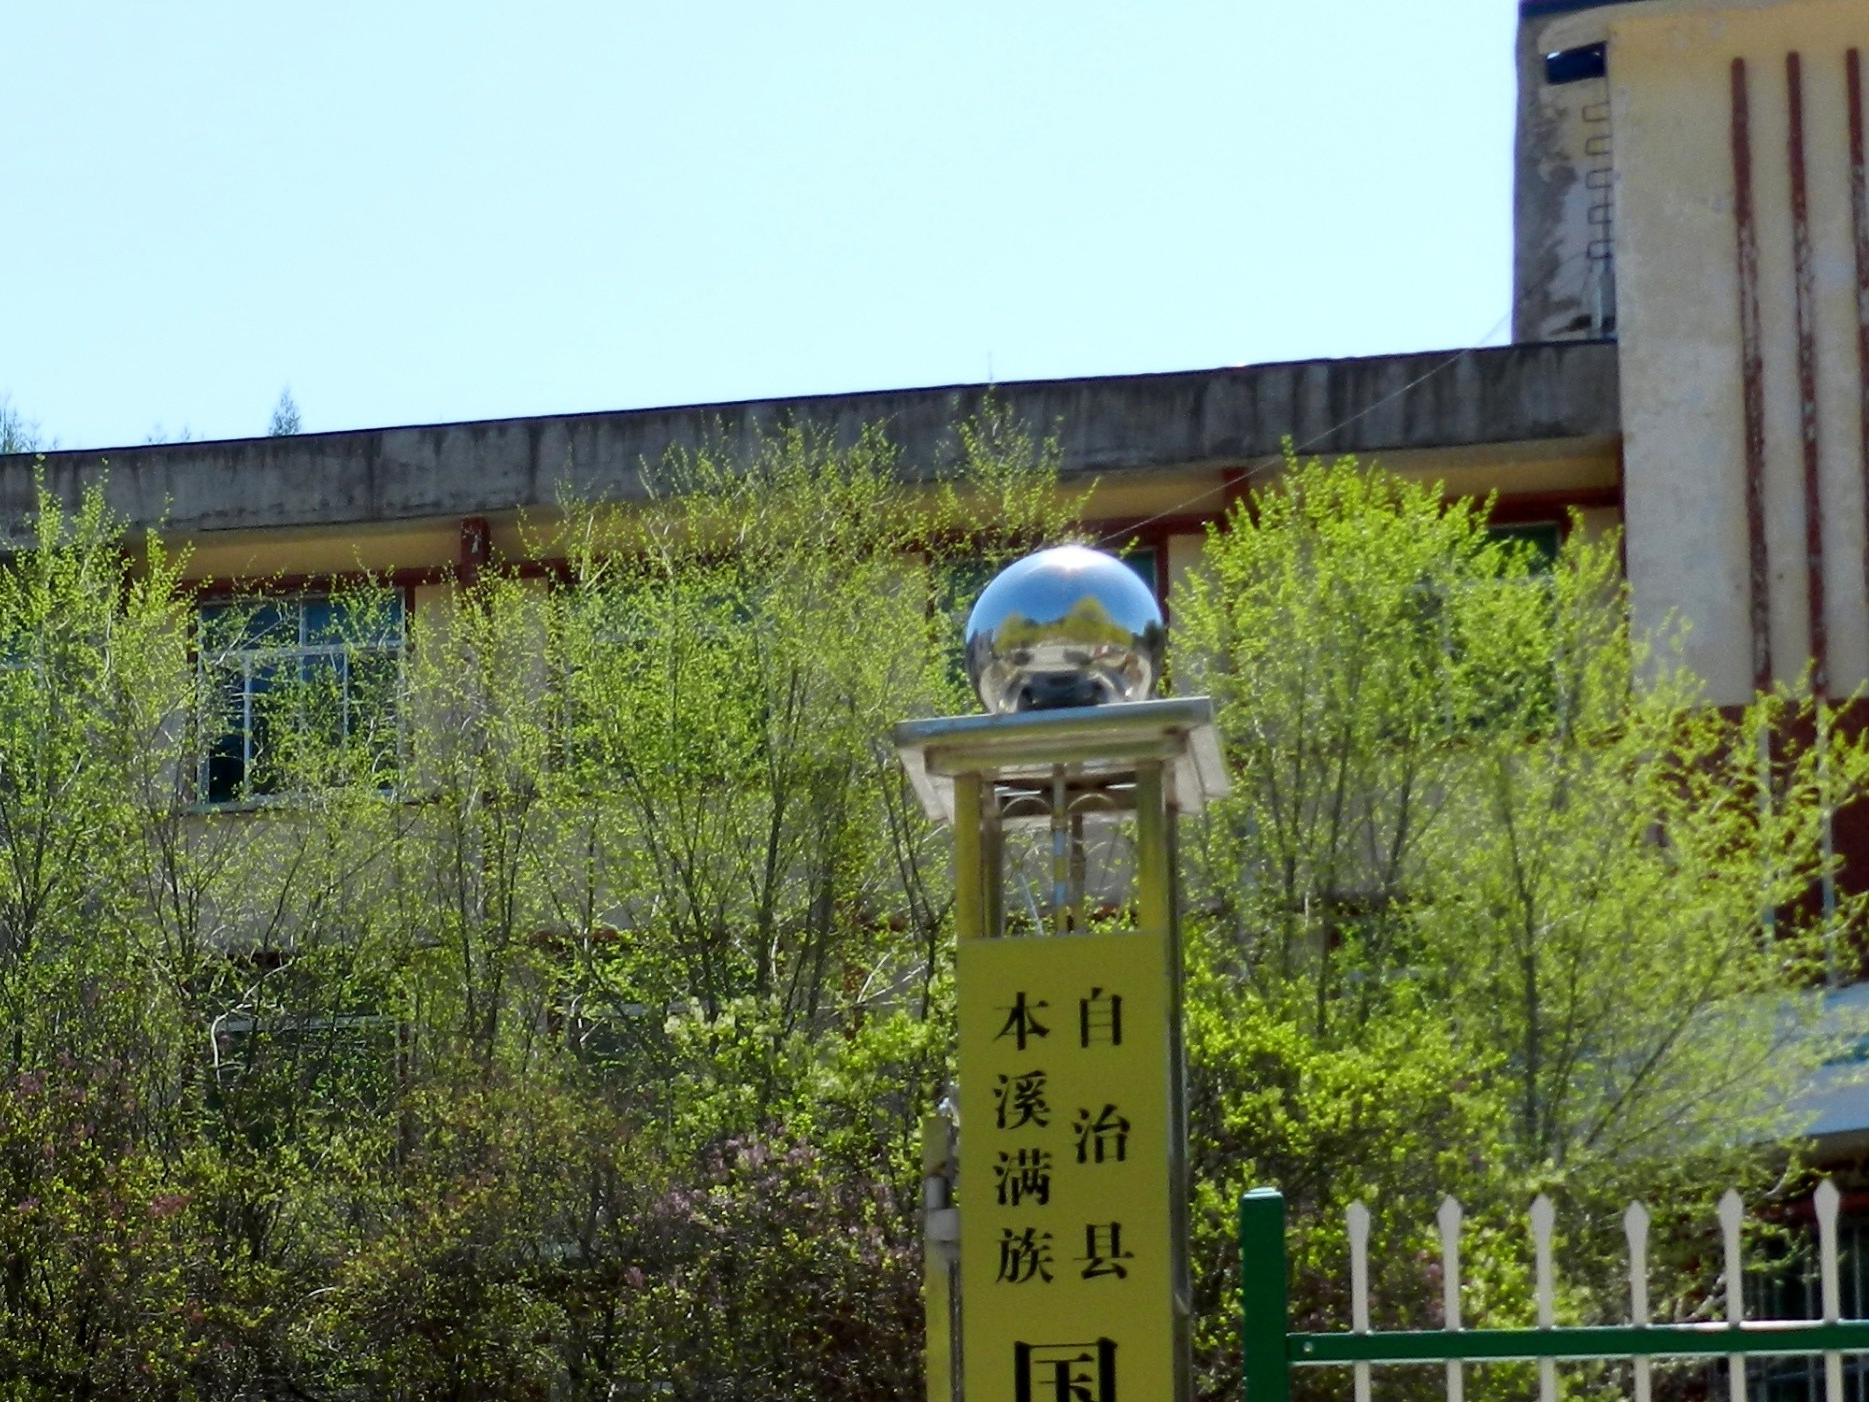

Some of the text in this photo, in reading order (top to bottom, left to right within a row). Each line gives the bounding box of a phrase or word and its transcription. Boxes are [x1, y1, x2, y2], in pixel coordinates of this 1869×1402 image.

[992, 990, 1054, 1285] 本溪满族
[1072, 986, 1135, 1280] 自治县
